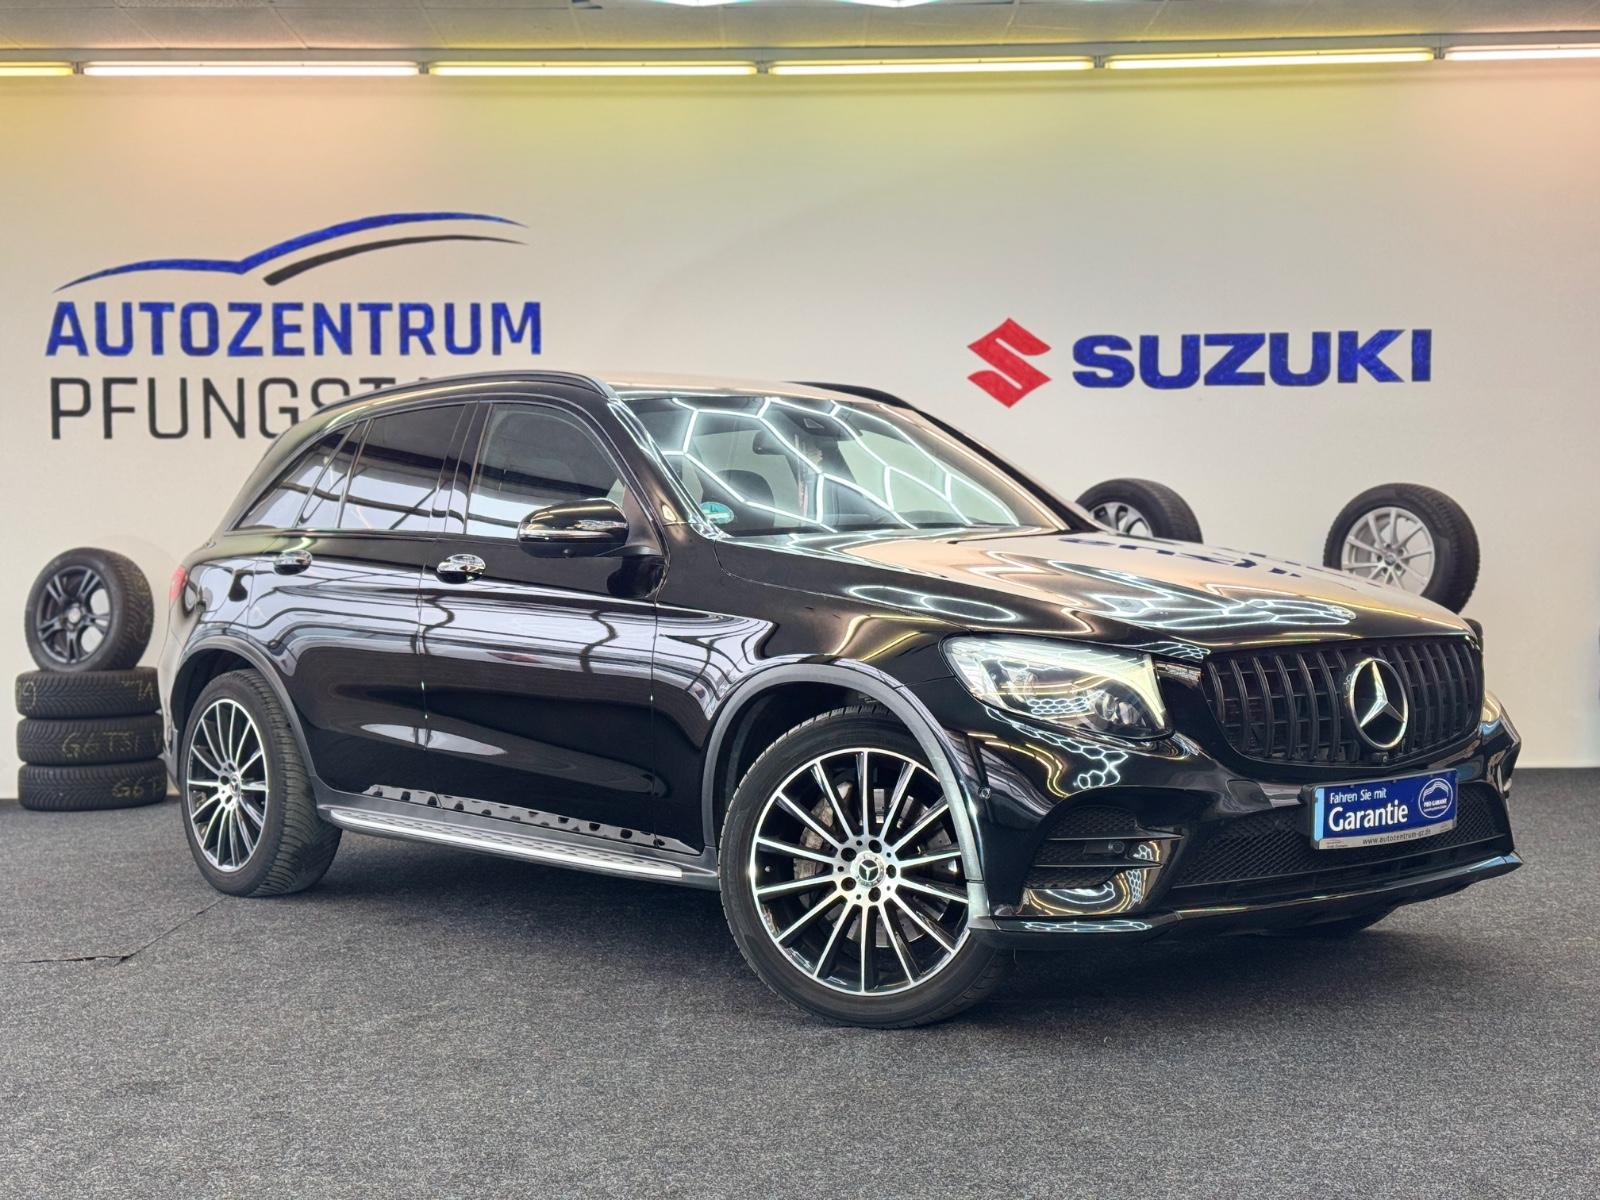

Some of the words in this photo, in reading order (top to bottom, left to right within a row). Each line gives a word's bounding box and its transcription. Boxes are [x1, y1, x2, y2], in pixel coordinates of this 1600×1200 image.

[45, 301, 541, 357] AUTOZENTRUM
[1072, 329, 1432, 390] SUZUKI
[1328, 799, 1409, 832] Garantie
[1330, 792, 1357, 804] Fahren
[1360, 789, 1372, 801] Sie
[1374, 787, 1387, 799] mit
